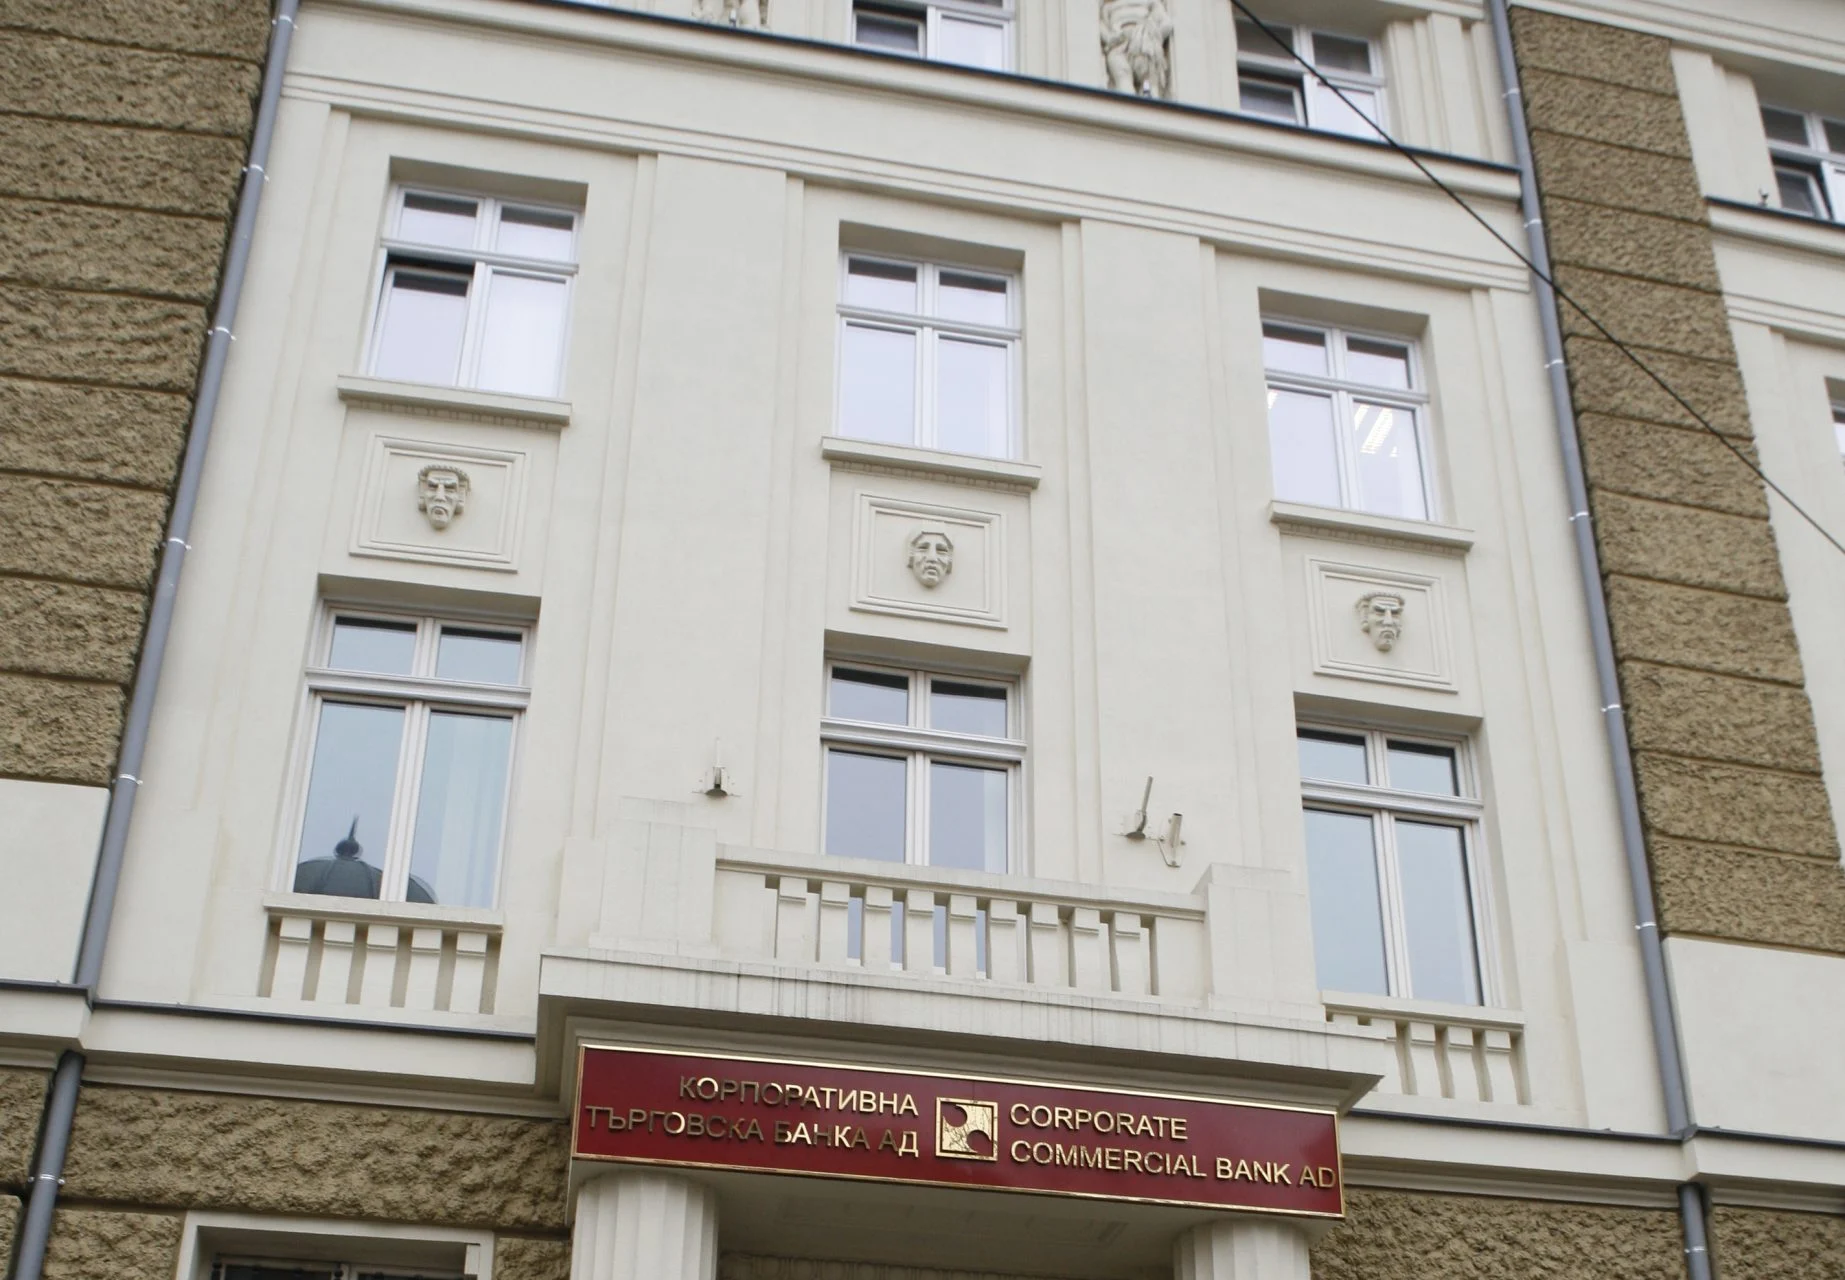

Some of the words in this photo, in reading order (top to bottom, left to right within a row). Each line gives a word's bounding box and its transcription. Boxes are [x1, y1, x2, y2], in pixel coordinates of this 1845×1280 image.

[680, 1076, 919, 1116] КОРПОРАТИВНА
[585, 1105, 764, 1142] ТЪРГОВСКА
[774, 1119, 870, 1150] БАНКА
[878, 1128, 919, 1157] АД
[1009, 1103, 1188, 1140] CORPORATE
[1009, 1139, 1207, 1178] COMMERCIAL
[1215, 1156, 1291, 1185] BANK
[1299, 1165, 1335, 1188] AD
